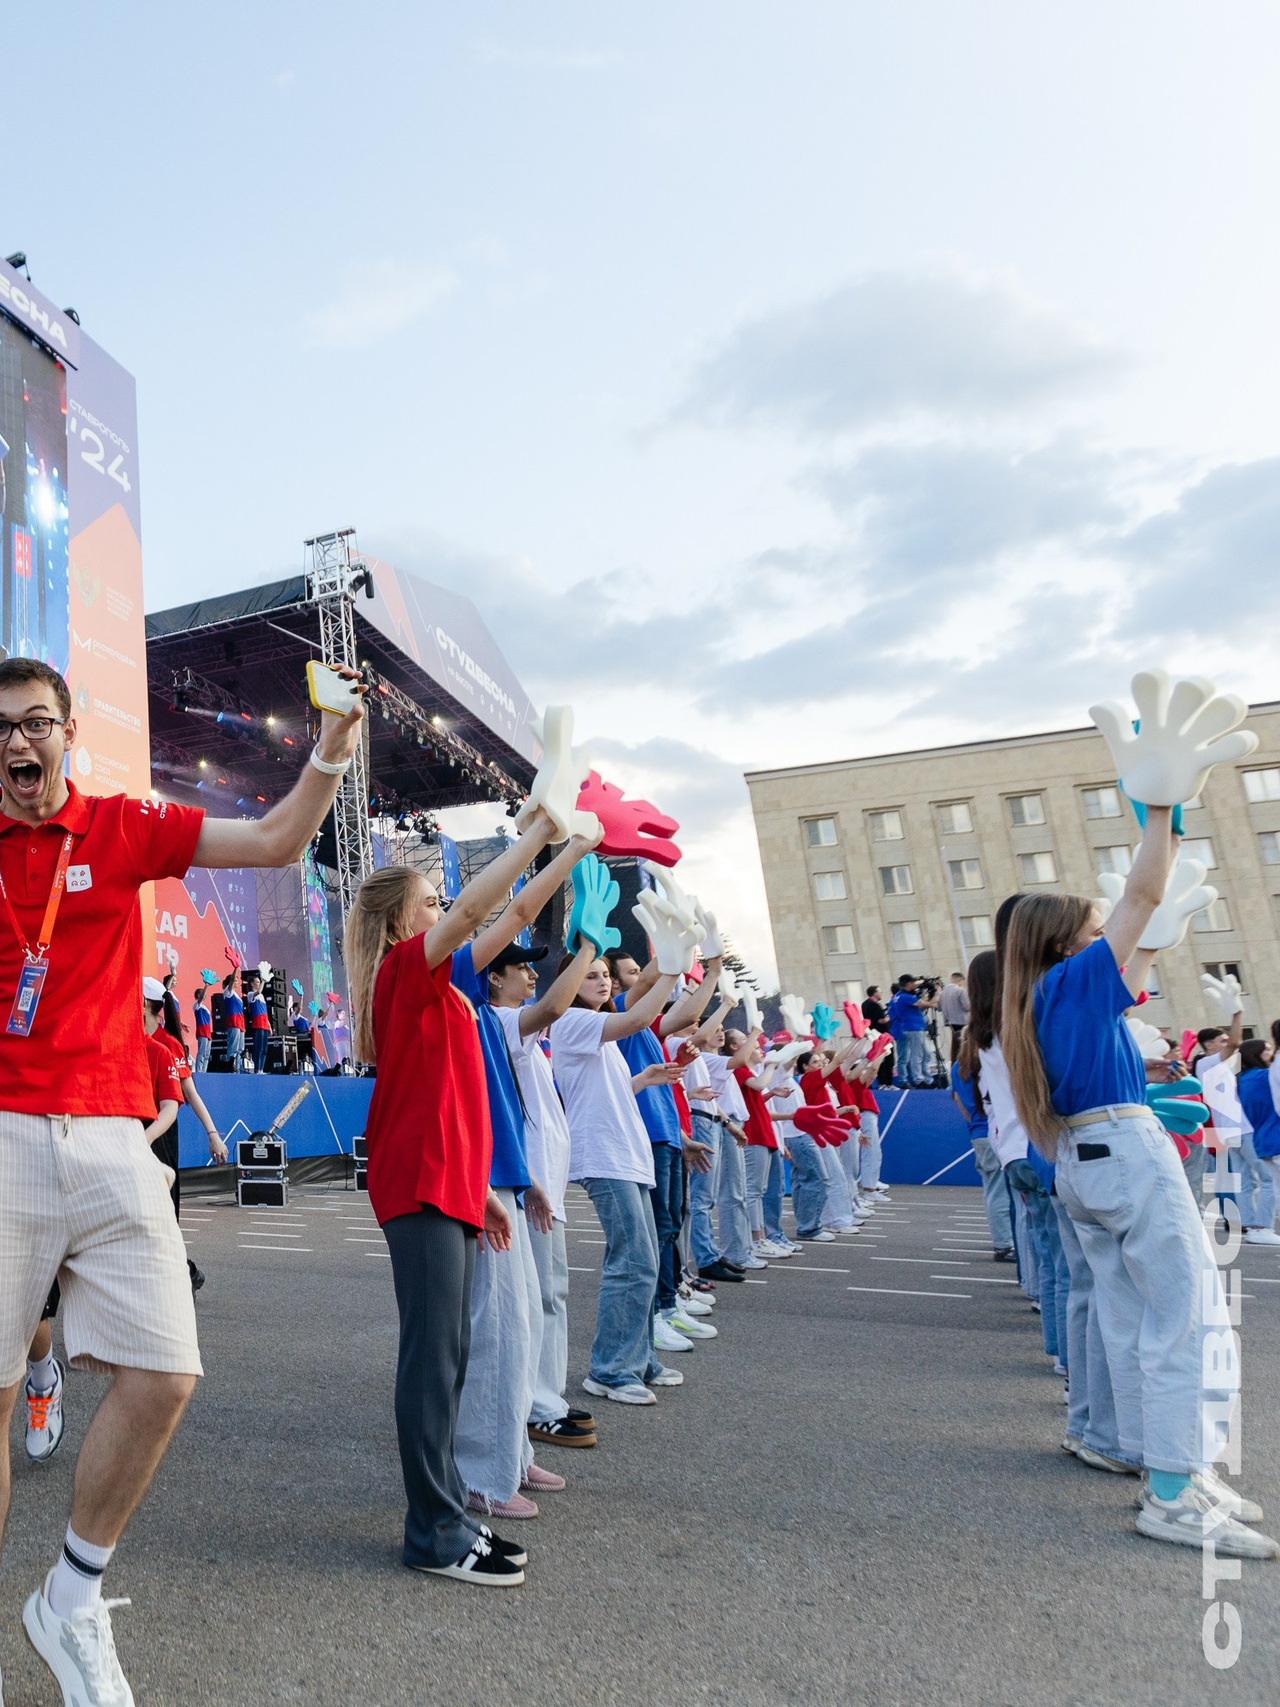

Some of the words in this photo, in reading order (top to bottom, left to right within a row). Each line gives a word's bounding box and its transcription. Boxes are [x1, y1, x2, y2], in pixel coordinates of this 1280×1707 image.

[69, 398, 130, 454] СТАВРОПОЛЬ
[435, 626, 517, 719] СТУДВЕСНА
[93, 698, 141, 728] ПРАВИТЕЛЬСТВО
[94, 752, 131, 773] РОССИЙСКИЙ
[94, 763, 111, 776] СОЮЗ
